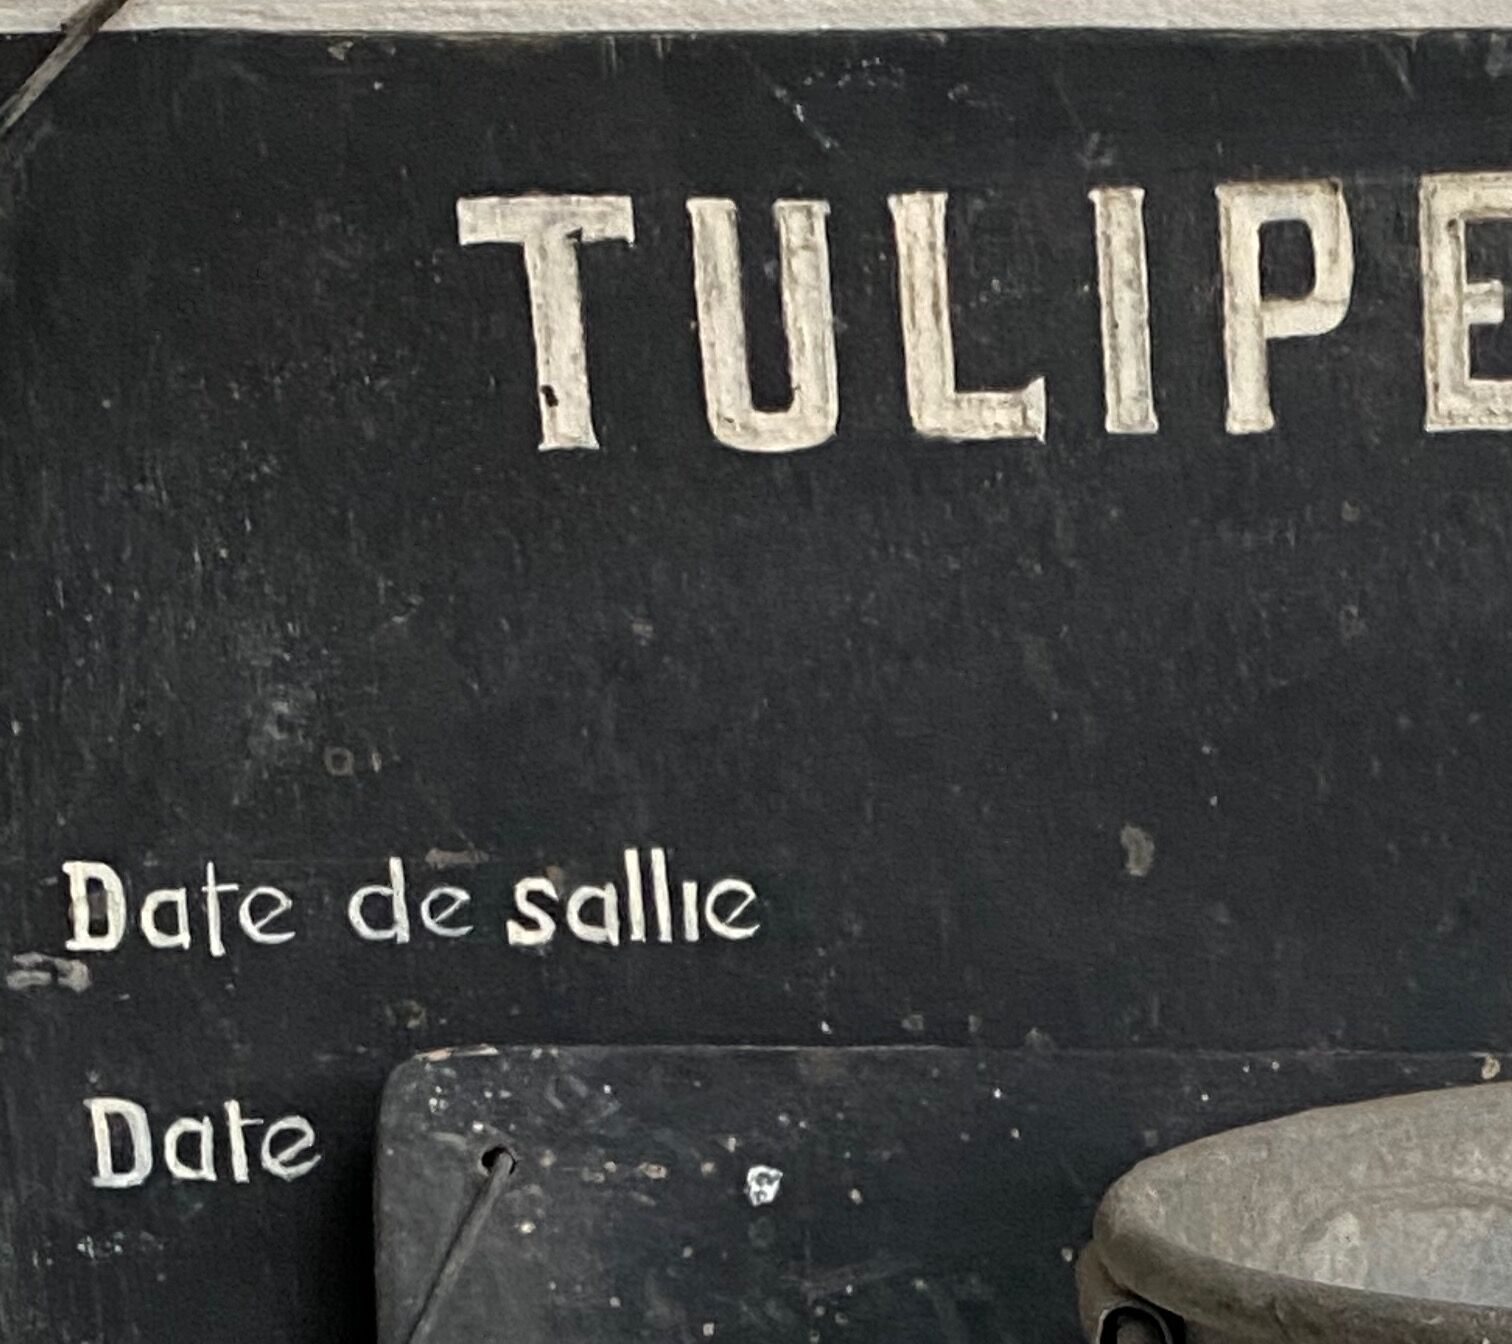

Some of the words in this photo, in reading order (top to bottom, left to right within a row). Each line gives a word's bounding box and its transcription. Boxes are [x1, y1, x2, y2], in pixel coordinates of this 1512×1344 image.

[62, 860, 297, 956] Date
[347, 857, 474, 943] de
[83, 1097, 322, 1189] Date
